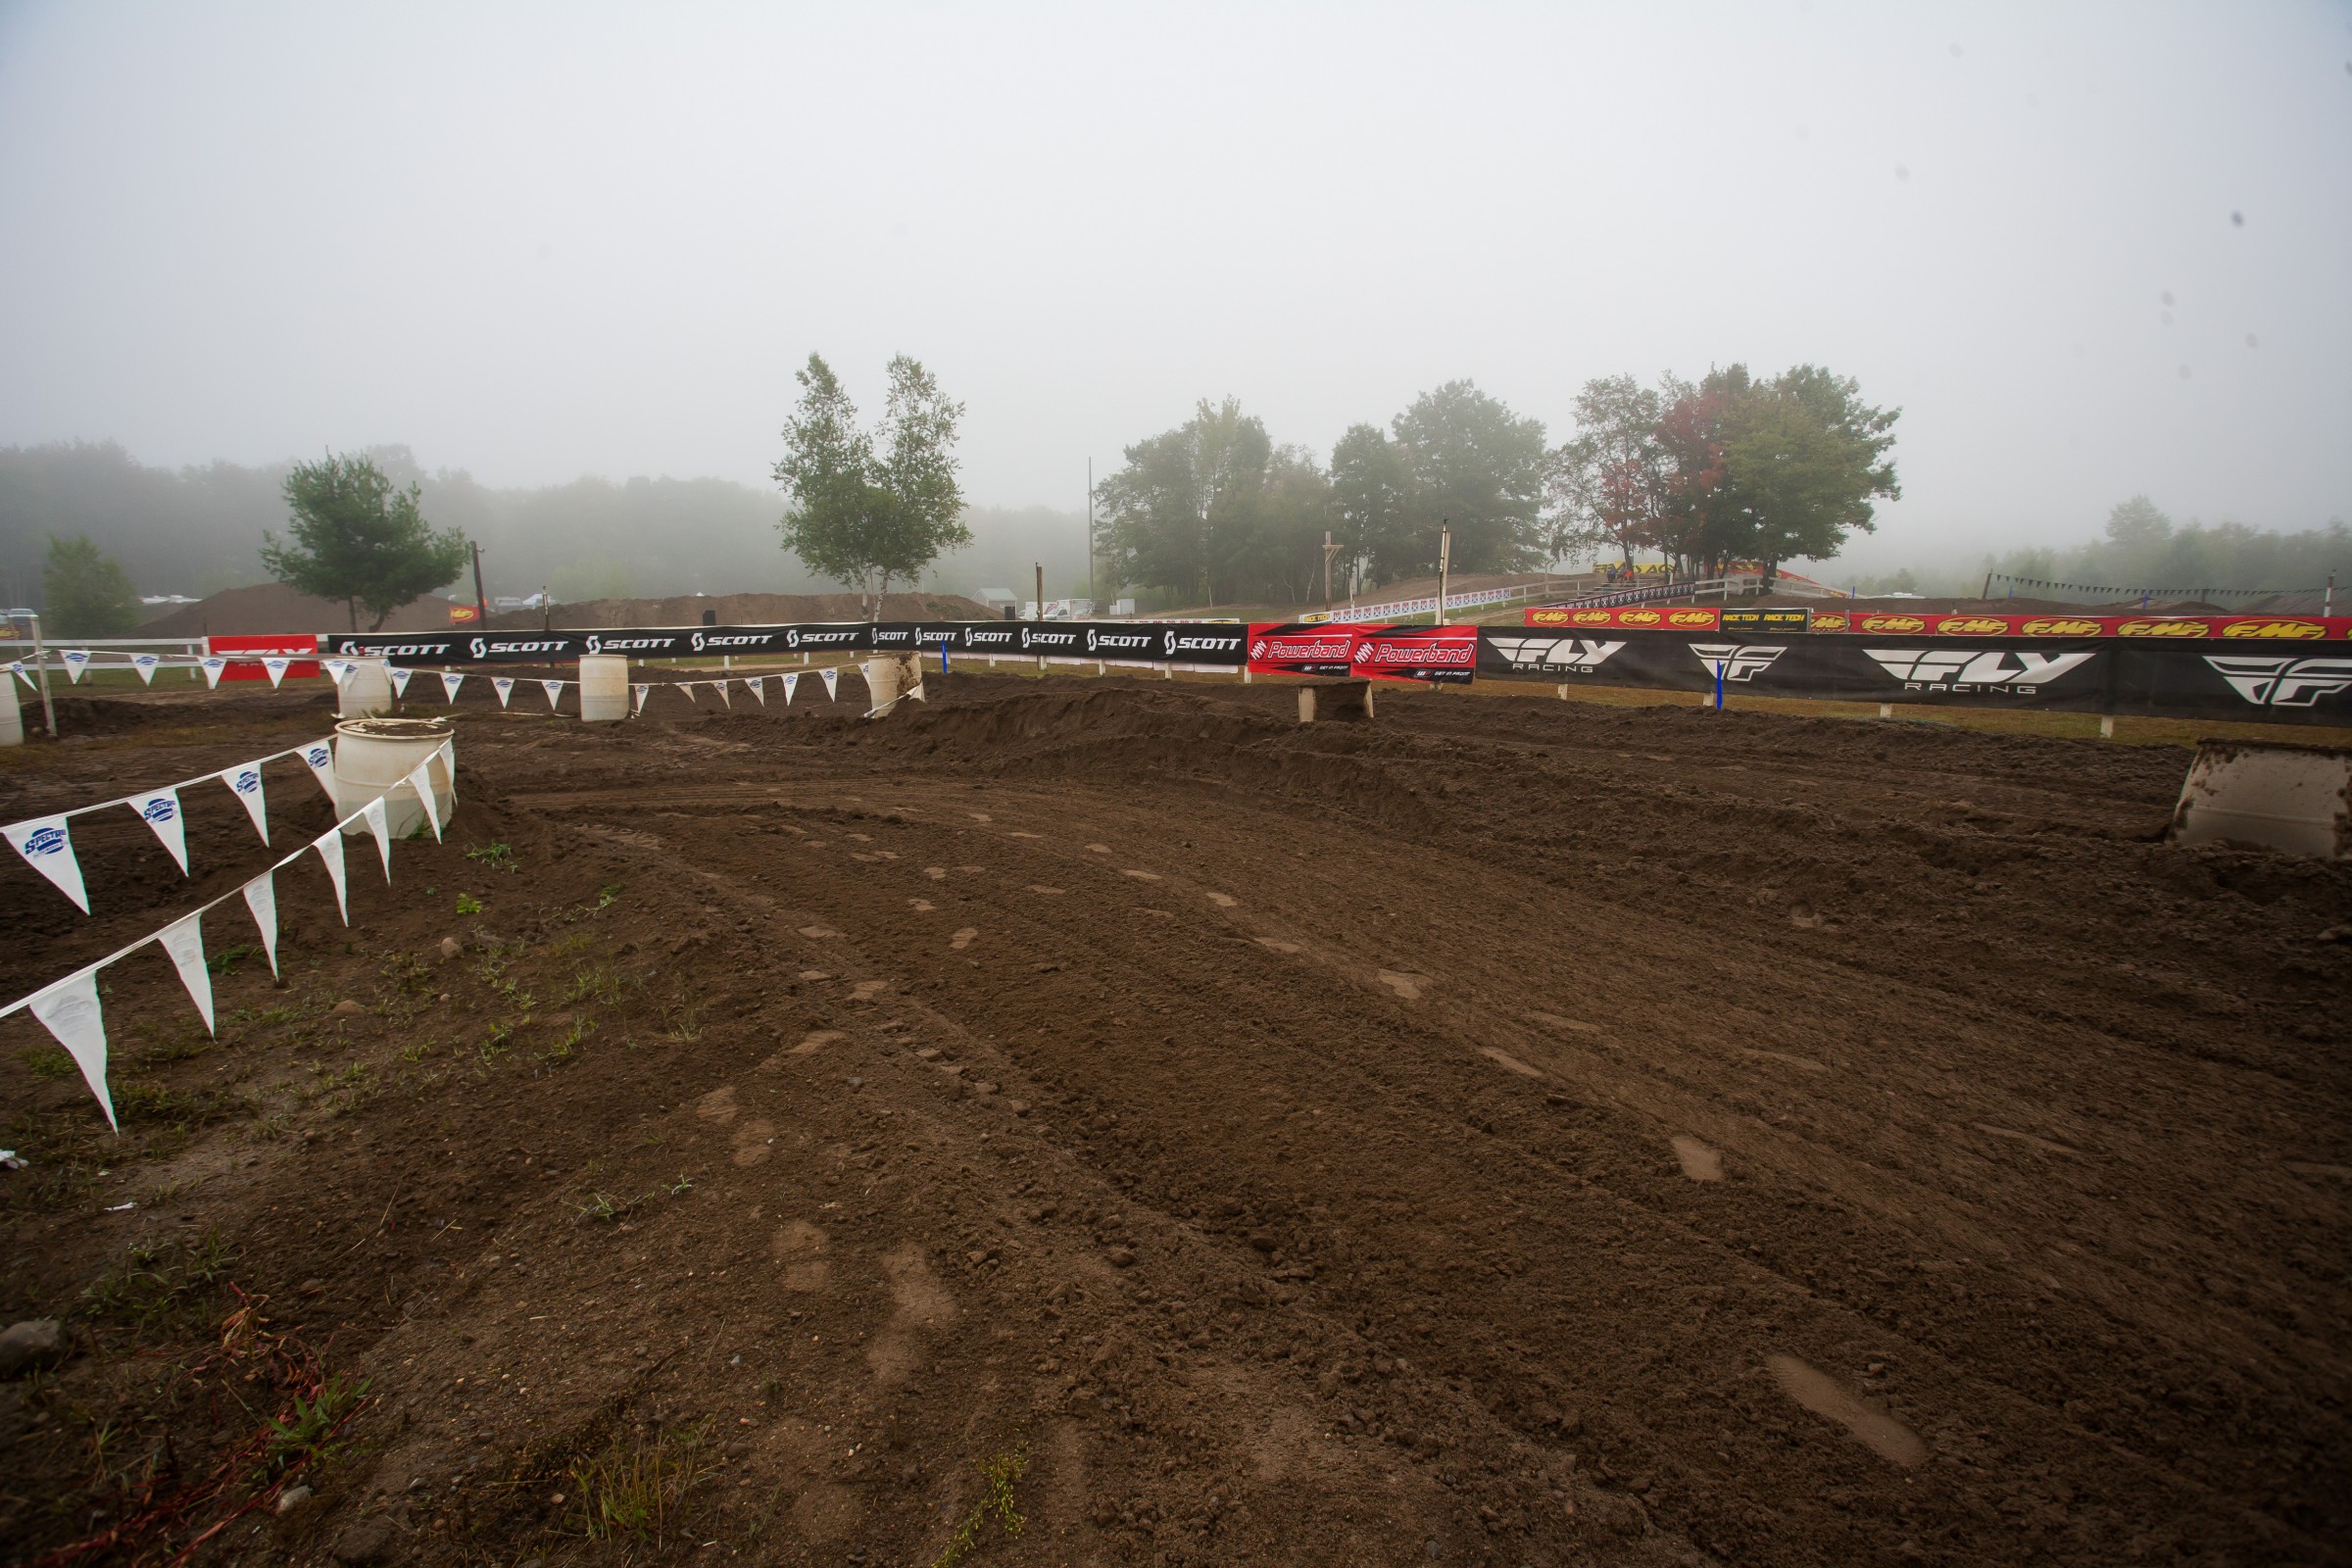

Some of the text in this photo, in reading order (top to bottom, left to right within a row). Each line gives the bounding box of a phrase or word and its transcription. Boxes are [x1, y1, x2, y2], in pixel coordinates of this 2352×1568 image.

[1533, 612, 1568, 621] FMF
[1573, 612, 1611, 622] FMF
[1619, 612, 1660, 622] FMF
[1669, 612, 1715, 623] FMF
[1811, 616, 1846, 628] MF
[1863, 618, 1925, 630] FMF
[1937, 619, 2007, 633] FMF
[2022, 620, 2102, 635] FMF
[2118, 621, 2208, 638] FMF
[878, 631, 908, 641] SCOTT
[922, 631, 957, 642] SCOTT
[2223, 622, 2327, 640] FMF
[707, 635, 773, 646] SCOTT
[801, 632, 859, 643] SCOTT
[973, 632, 1013, 643] SCOTT
[1030, 633, 1076, 645] SCOTT
[1098, 635, 1152, 648] SCOTT
[365, 644, 451, 656] SCOTT
[489, 641, 569, 653] SCOTT
[603, 638, 676, 650] SCOTT
[1177, 637, 1242, 651] SCOTT
[1267, 638, 1350, 660] Powerband
[1375, 640, 1474, 663] Powerband
[1495, 638, 1628, 665] FLY
[1512, 663, 1593, 673] RACING
[1878, 650, 2097, 684] FLY
[1904, 681, 2036, 694] RACING
